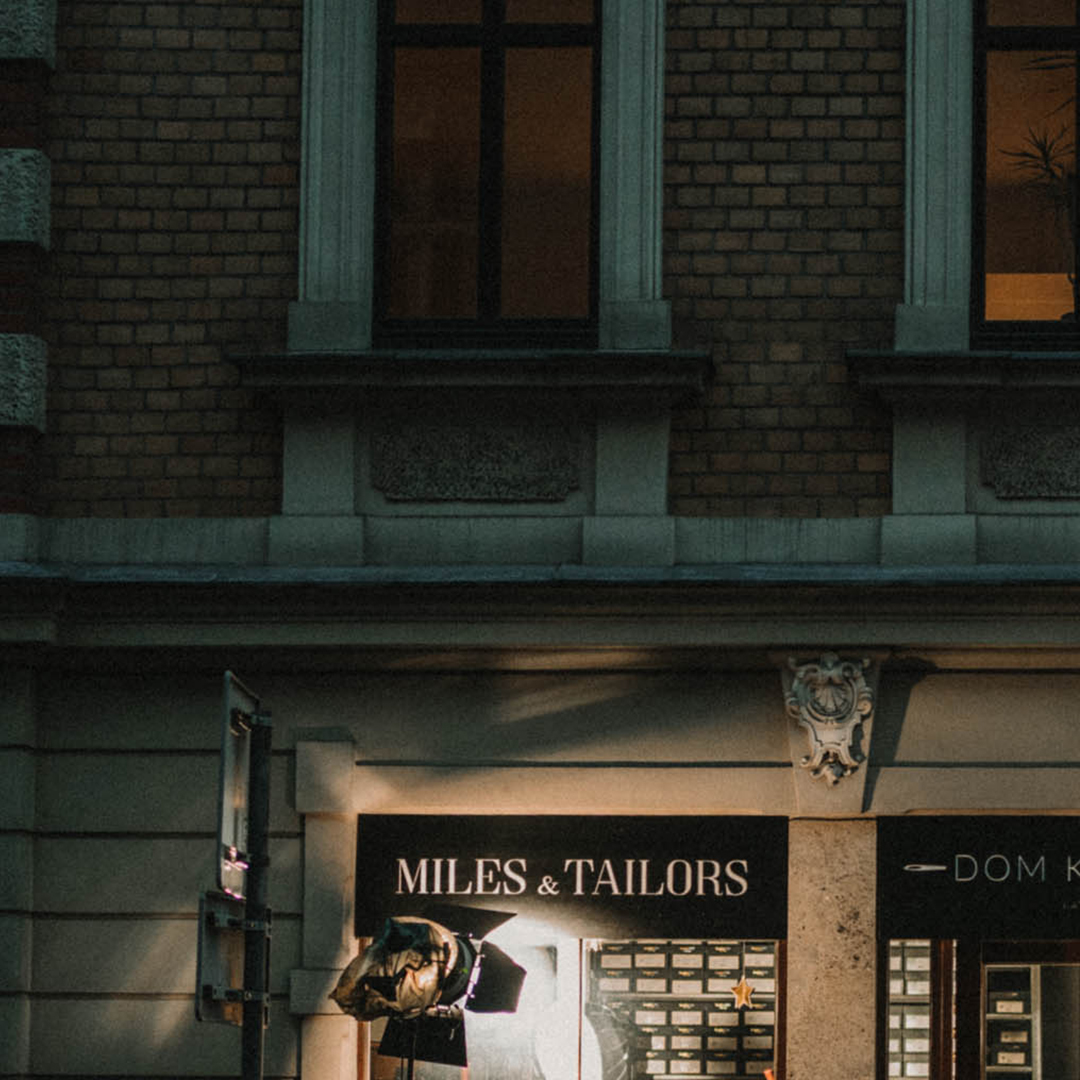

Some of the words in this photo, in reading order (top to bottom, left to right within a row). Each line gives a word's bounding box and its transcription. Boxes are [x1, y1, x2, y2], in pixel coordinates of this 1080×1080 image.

[395, 858, 527, 895] MILES
[537, 875, 560, 895] &
[564, 859, 749, 896] TAILORS
[954, 854, 1045, 882] DOM
